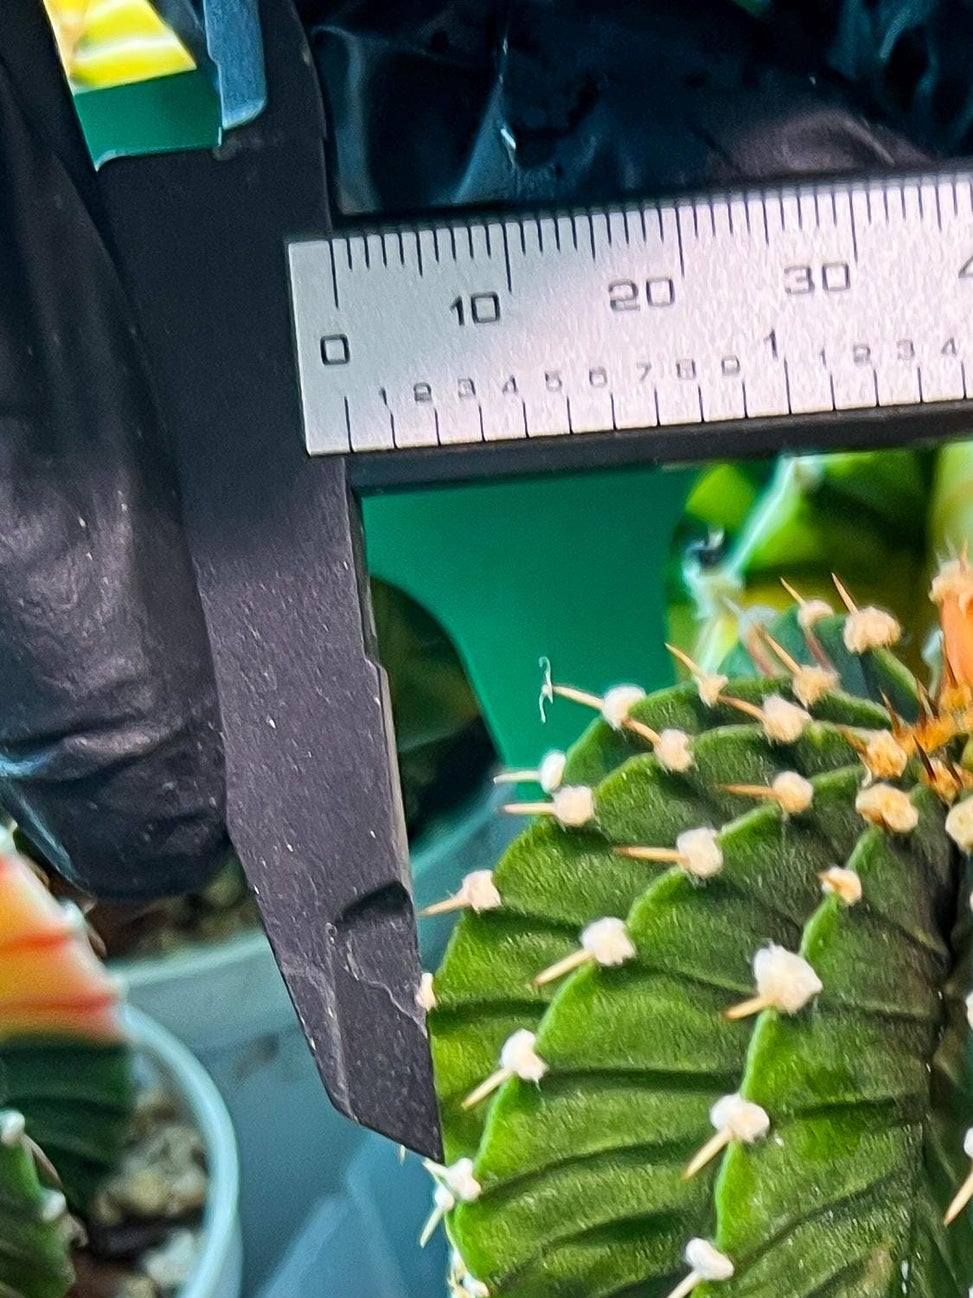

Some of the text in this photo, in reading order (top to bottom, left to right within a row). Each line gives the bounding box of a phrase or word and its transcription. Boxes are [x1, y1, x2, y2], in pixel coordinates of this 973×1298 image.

[450, 291, 502, 326] 10
[608, 276, 675, 312] 20
[783, 262, 851, 295] 30
[320, 334, 350, 366] 0
[502, 374, 519, 394] 4
[637, 361, 652, 382] 7
[763, 328, 779, 360] 1
[940, 336, 957, 355] 4
